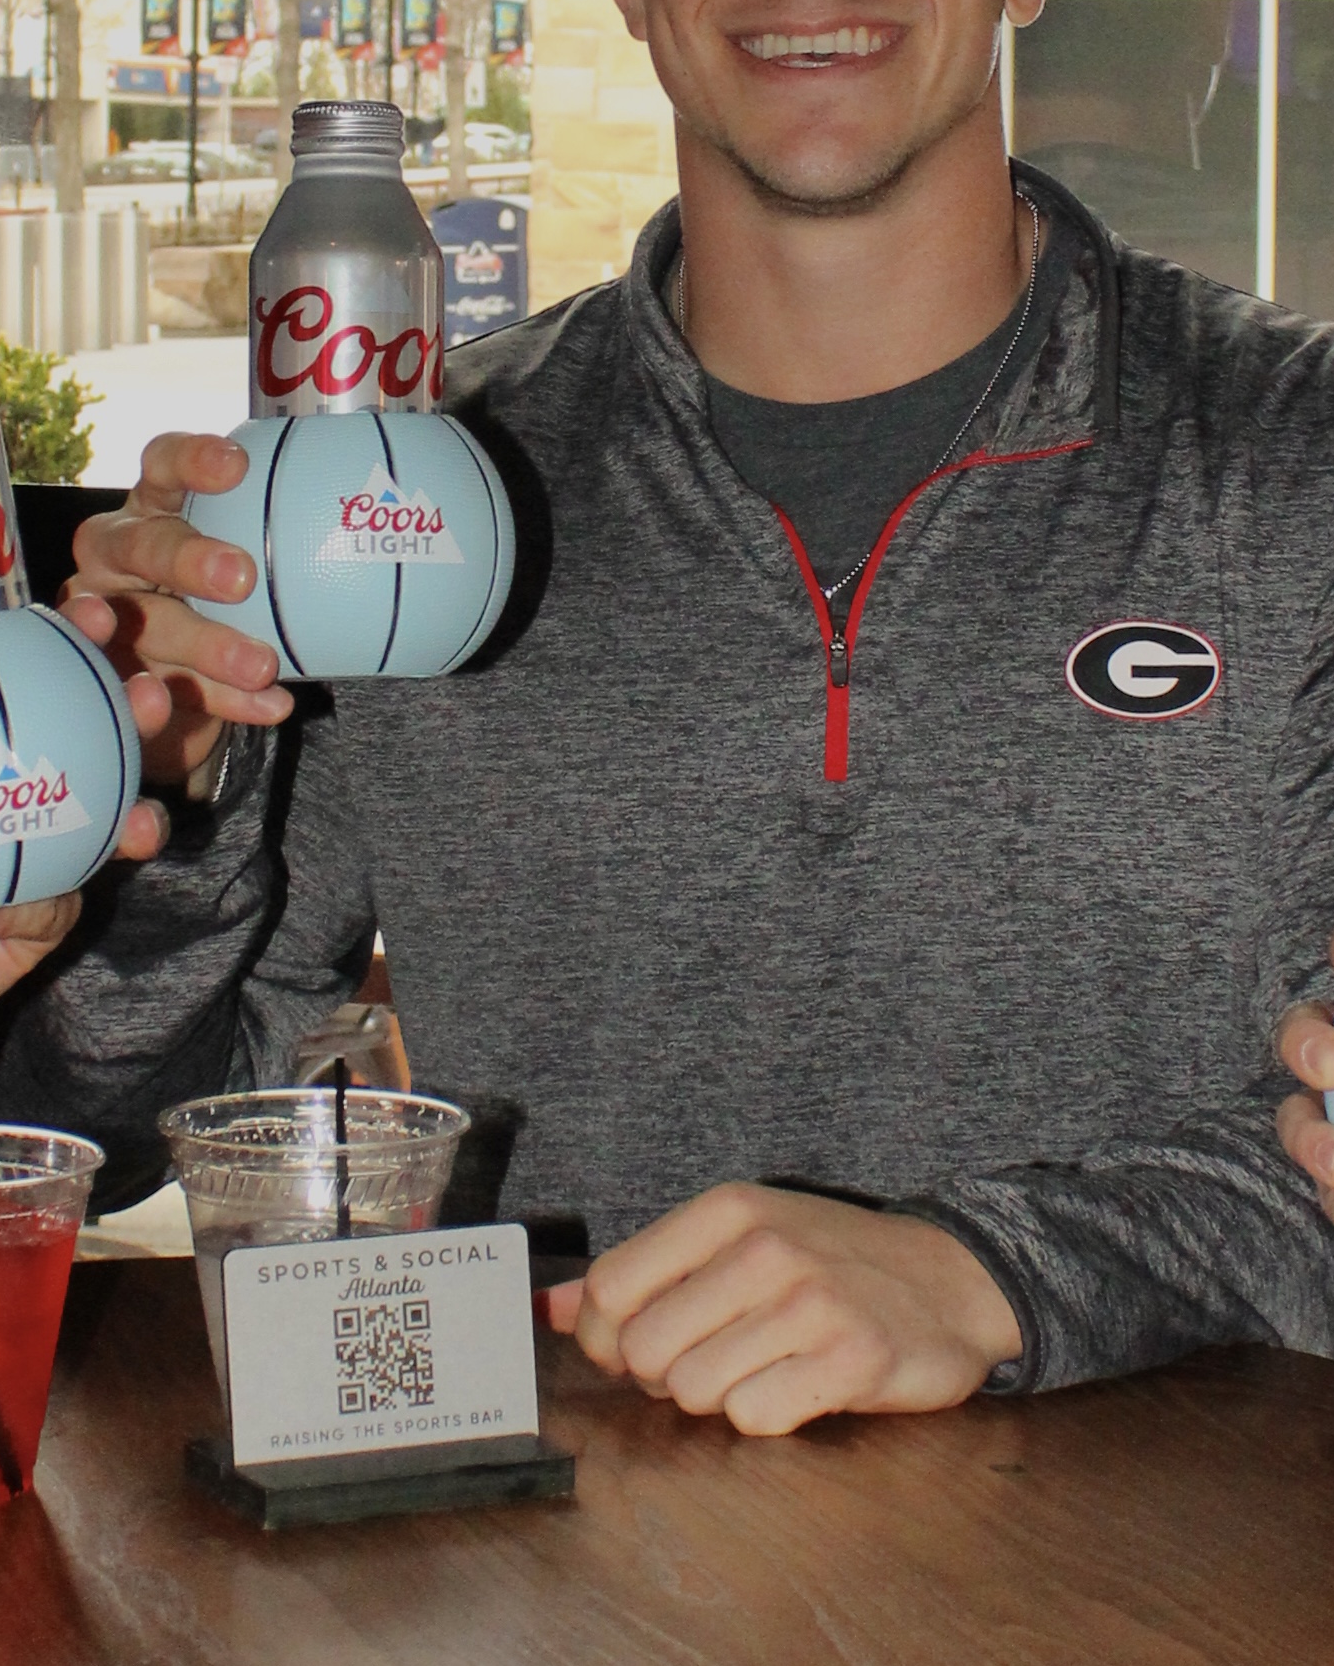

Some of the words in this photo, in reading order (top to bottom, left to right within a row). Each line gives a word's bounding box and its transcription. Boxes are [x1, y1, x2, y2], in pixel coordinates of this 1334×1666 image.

[255, 285, 445, 401] Coo
[339, 492, 446, 533] Coors
[353, 535, 435, 556] LIGHT
[257, 1256, 362, 1285] SPORTS
[373, 1254, 388, 1272] &
[401, 1243, 500, 1270] SOCIAL
[337, 1274, 427, 1302] Atlanta
[269, 1427, 346, 1450] RAISING
[353, 1423, 386, 1439] THE
[393, 1414, 463, 1435] SPORTS
[469, 1408, 505, 1426] BAR
